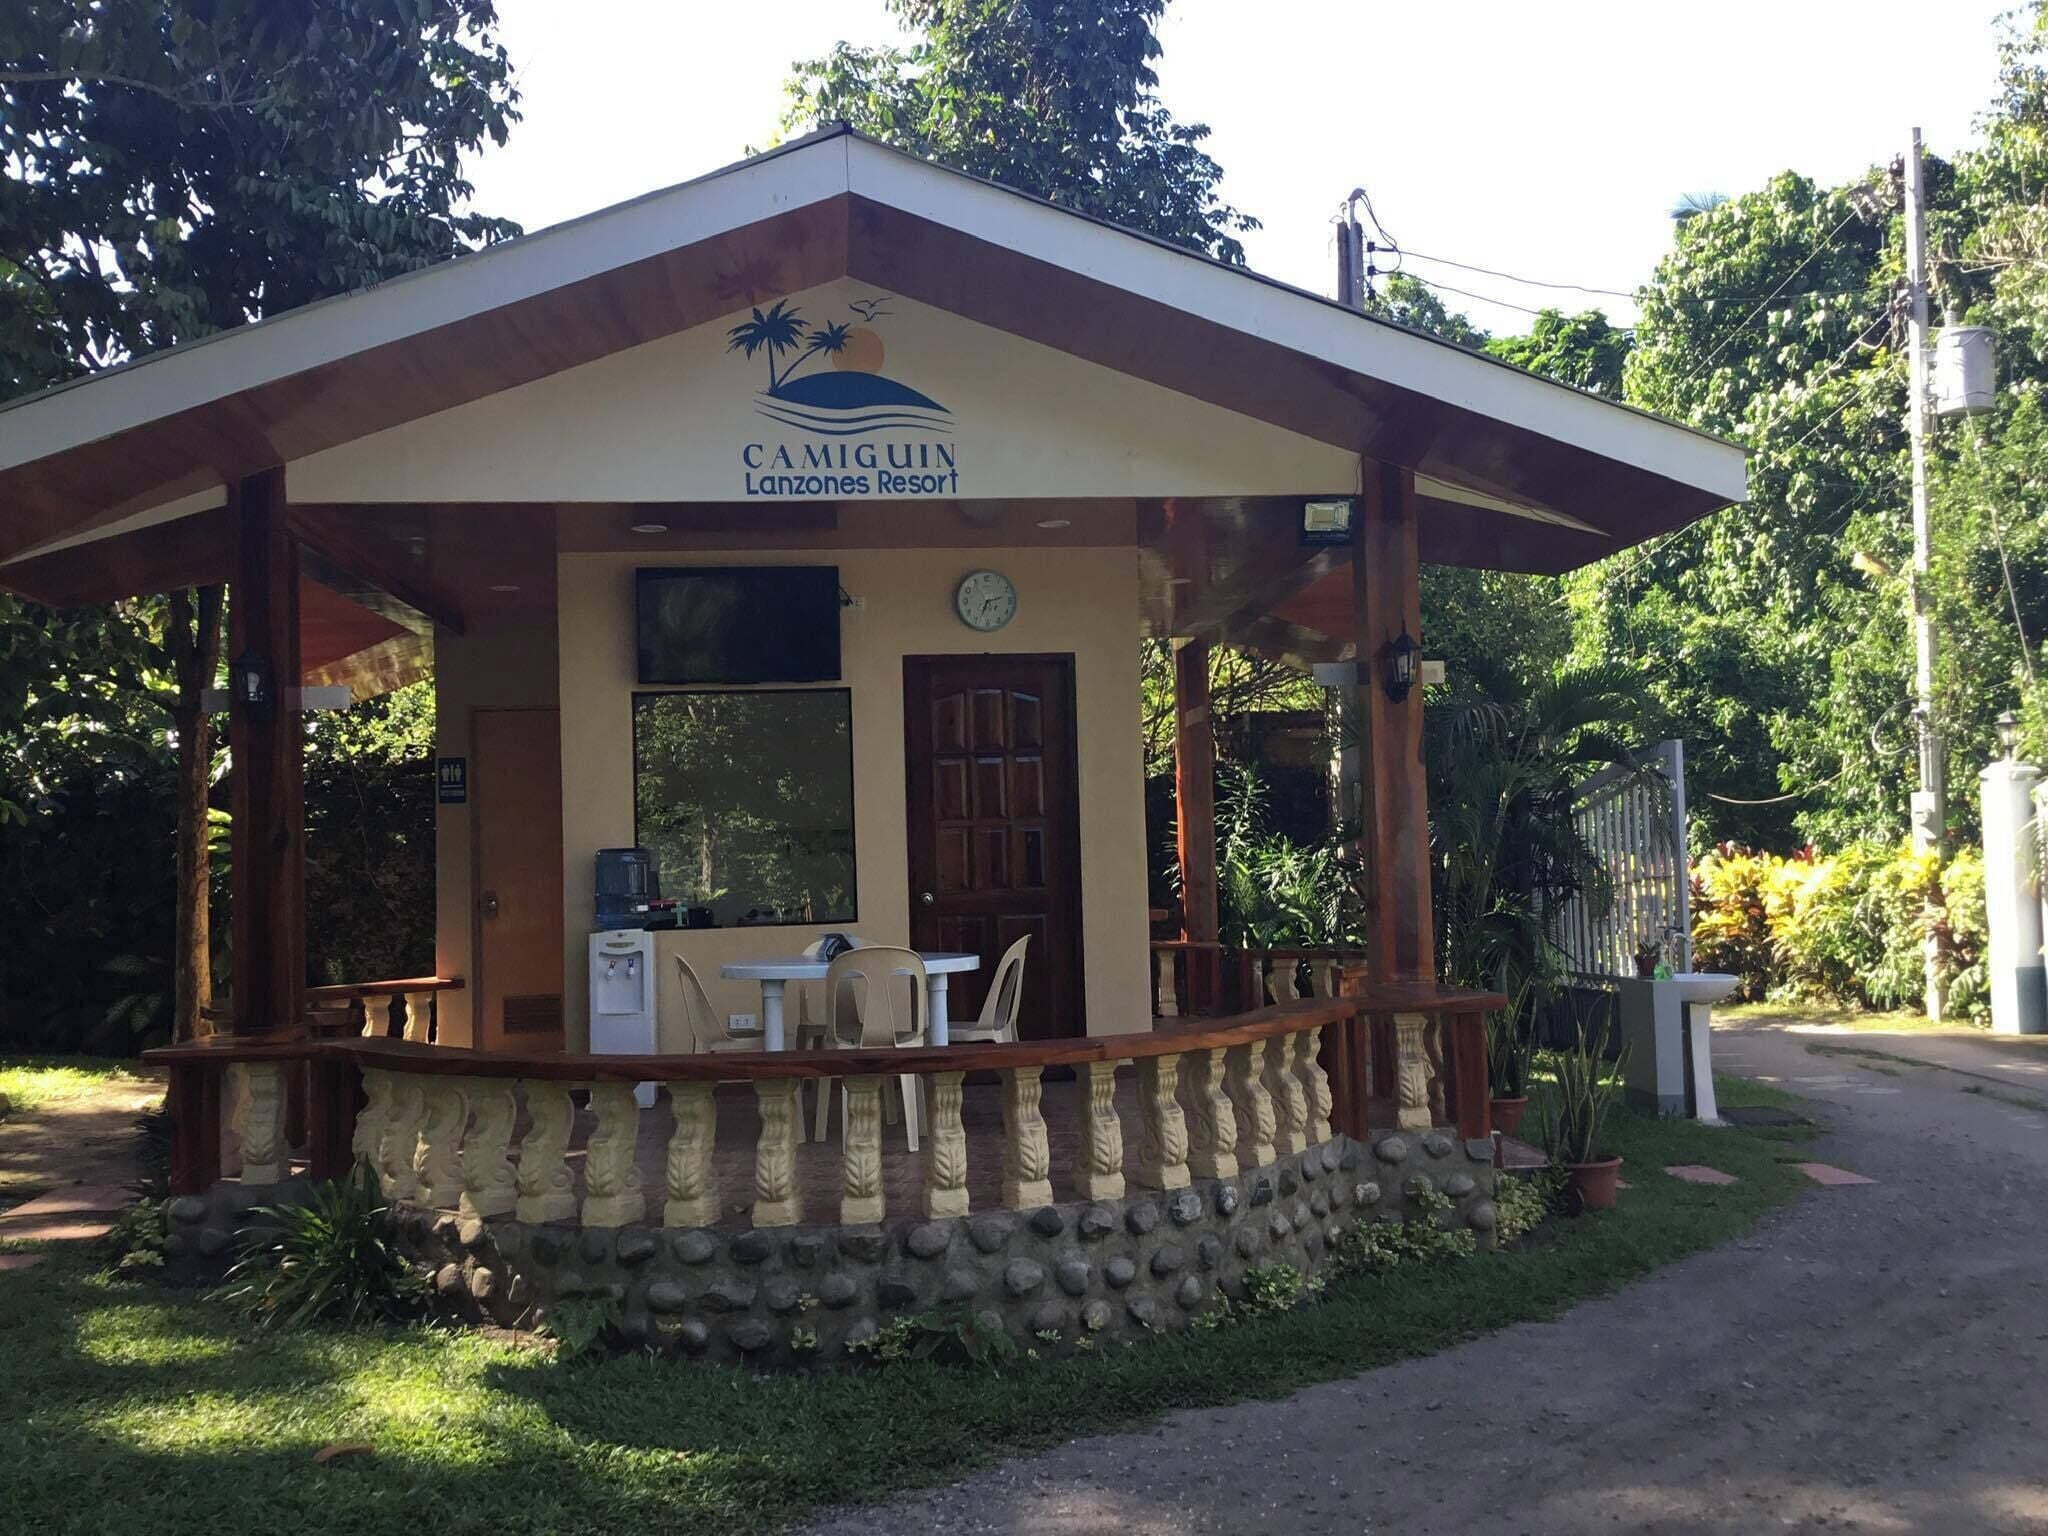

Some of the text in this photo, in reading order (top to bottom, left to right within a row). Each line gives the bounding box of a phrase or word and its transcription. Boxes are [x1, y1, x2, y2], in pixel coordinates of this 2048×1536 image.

[743, 443, 955, 469] CAMIGUIN
[745, 468, 959, 495] Lanzones Resort
